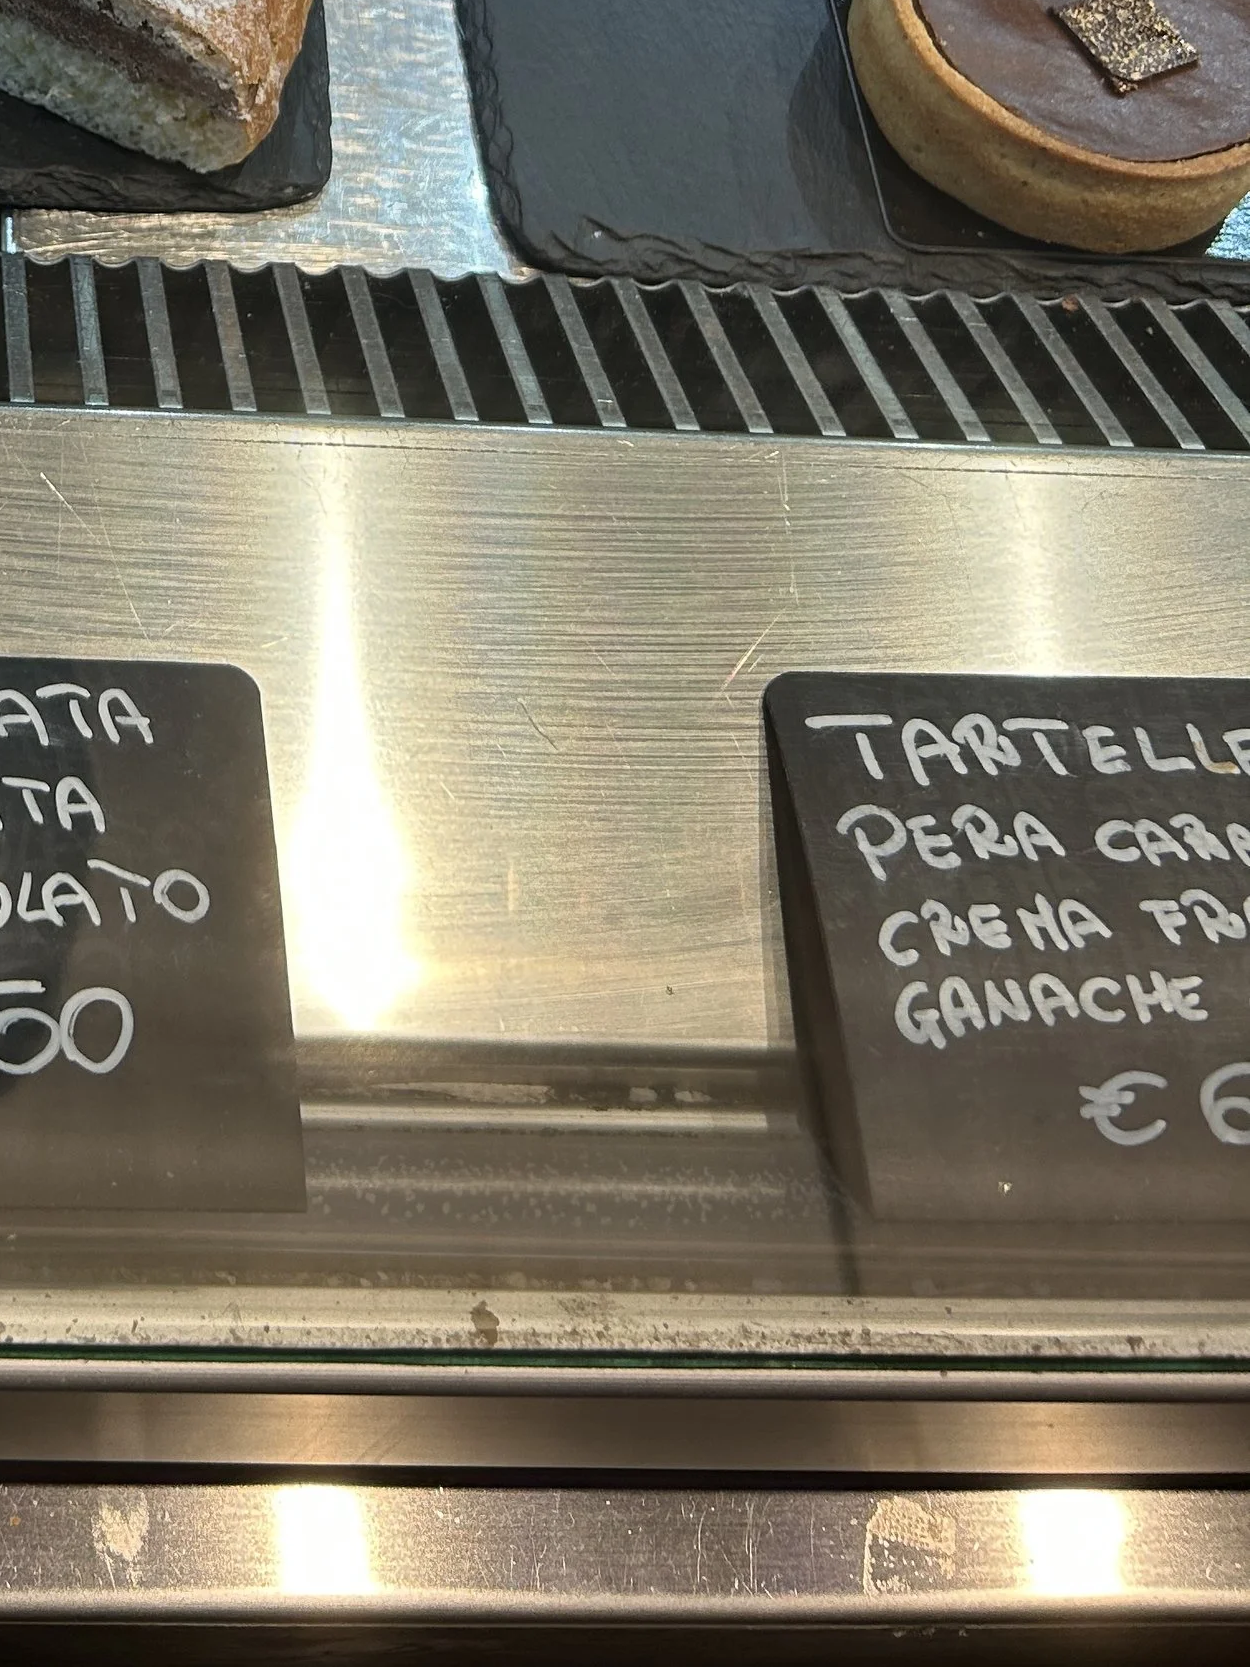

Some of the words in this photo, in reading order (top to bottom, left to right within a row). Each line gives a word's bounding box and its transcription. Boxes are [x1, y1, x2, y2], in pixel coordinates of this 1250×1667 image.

[836, 803, 1066, 882] PERA
[877, 893, 1113, 967] CREMA
[1140, 889, 1250, 945] FR
[894, 970, 1209, 1050] GANACHE
[1079, 1069, 1168, 1146] €
